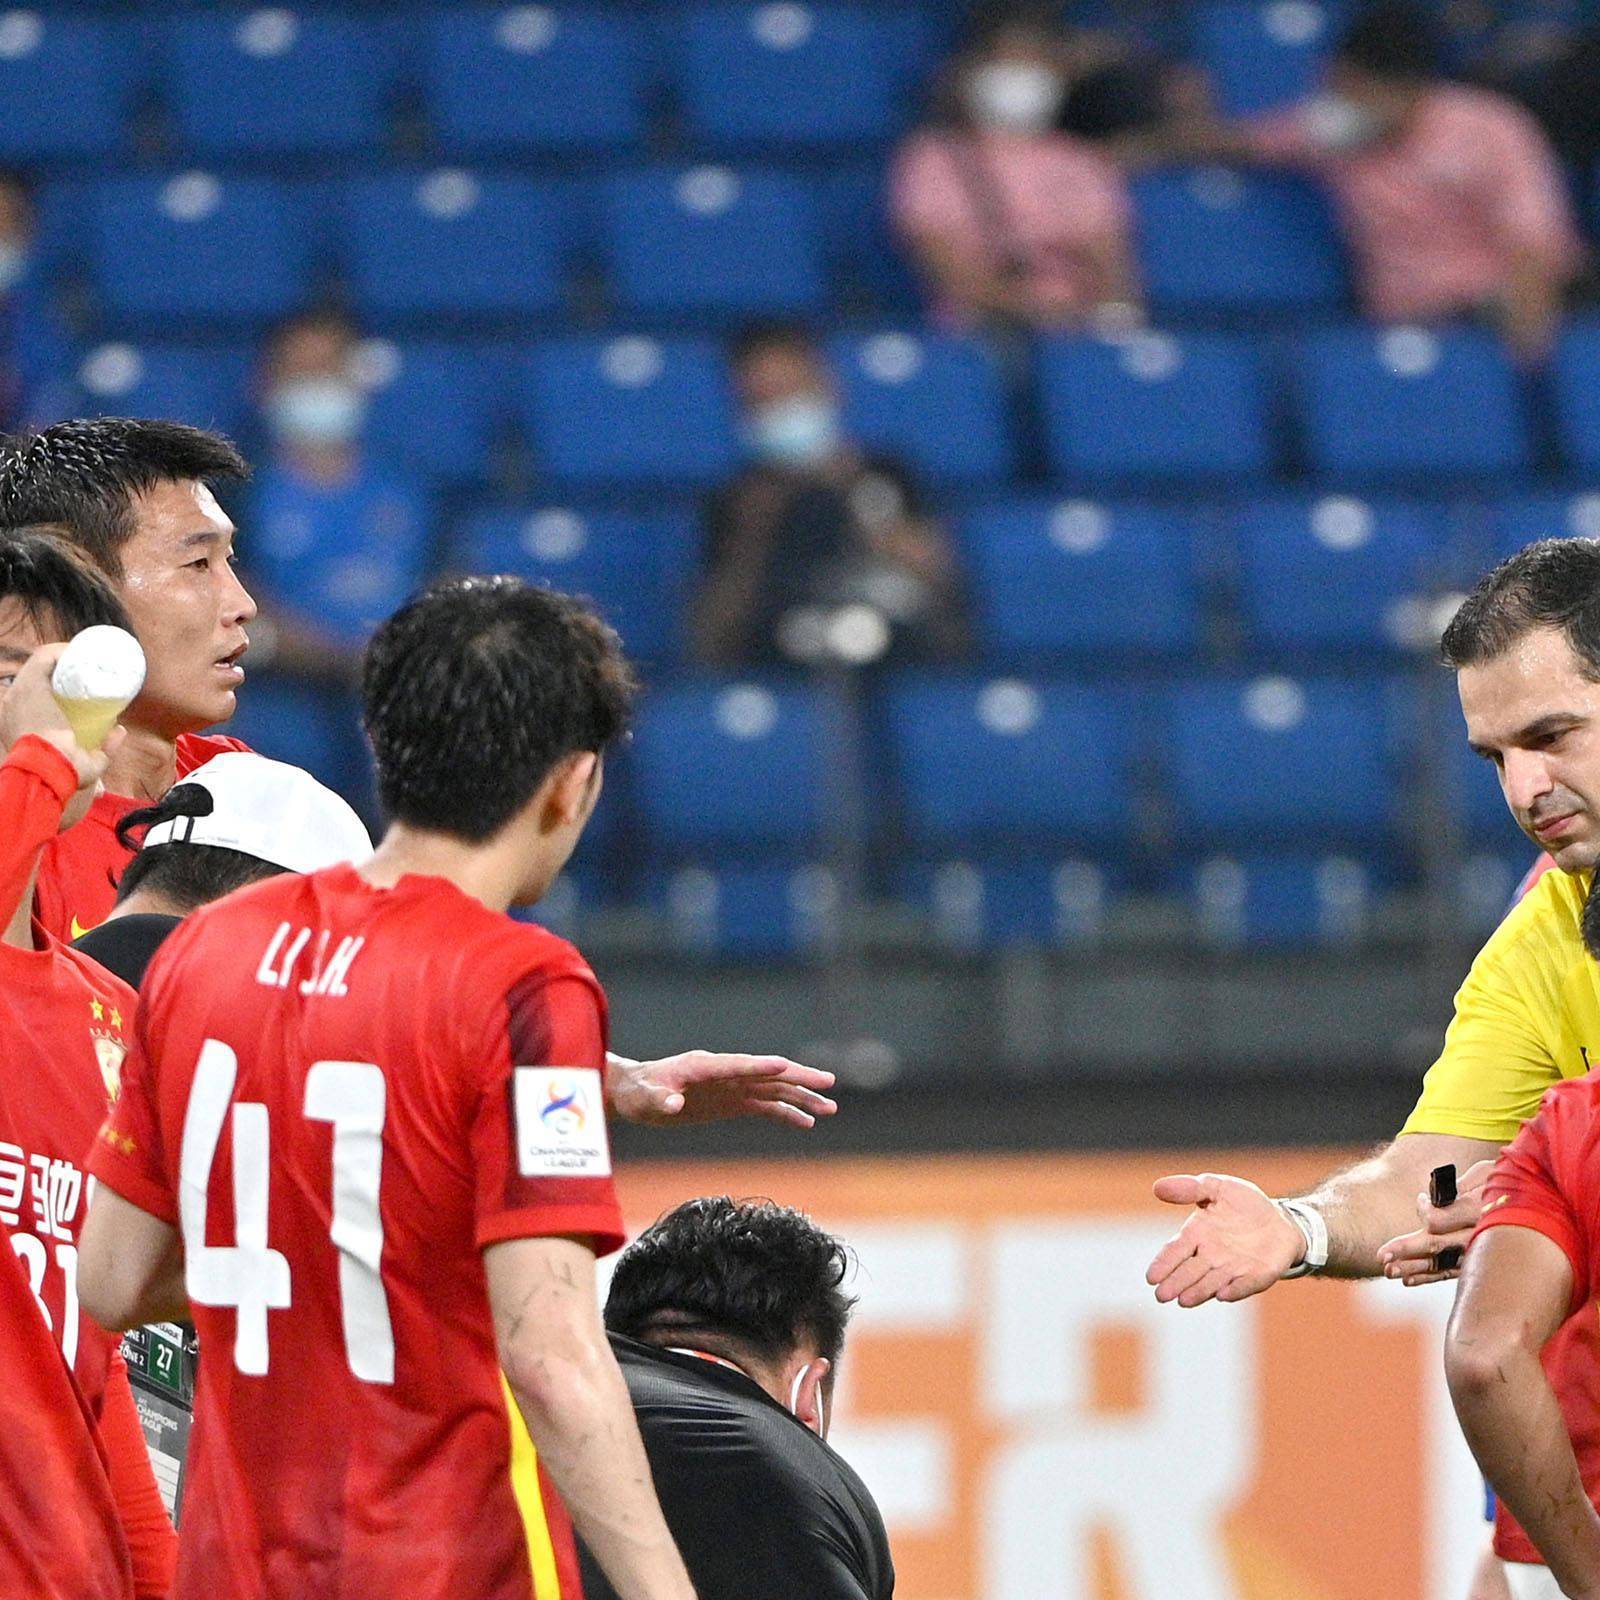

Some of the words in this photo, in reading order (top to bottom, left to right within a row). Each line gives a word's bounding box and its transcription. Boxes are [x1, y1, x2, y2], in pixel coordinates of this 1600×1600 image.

[257, 921, 312, 989] LI
[180, 1038, 395, 1386] 41
[156, 1344, 174, 1371] 27
